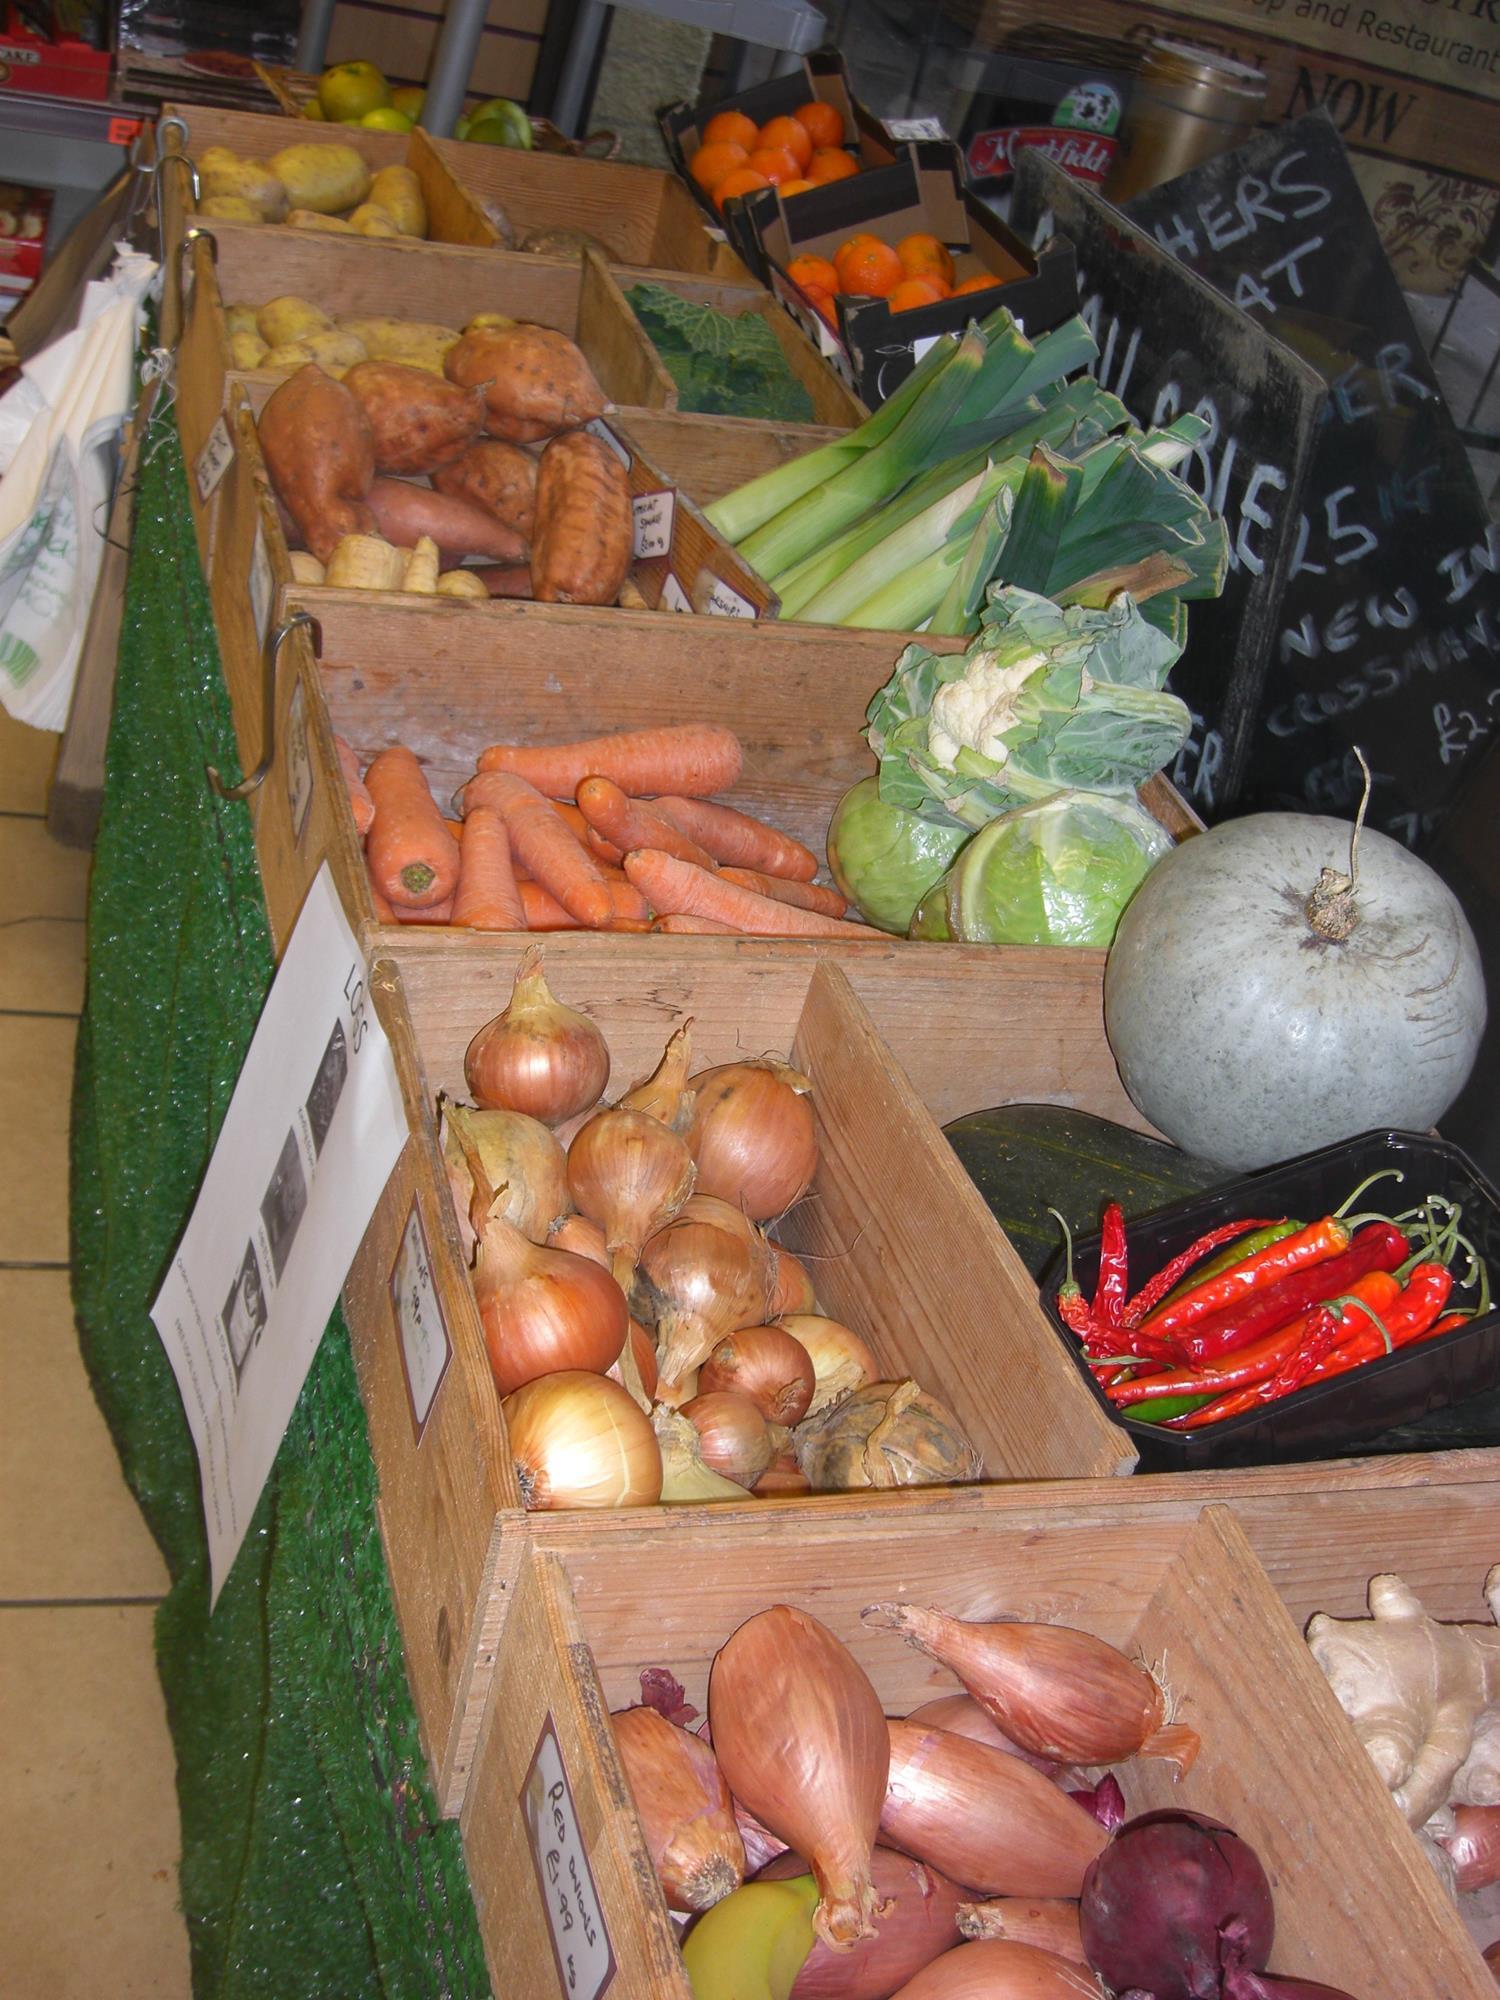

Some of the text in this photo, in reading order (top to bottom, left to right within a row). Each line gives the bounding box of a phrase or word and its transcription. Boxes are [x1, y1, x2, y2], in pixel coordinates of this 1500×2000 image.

[1294, 0, 1349, 29] and
[1355, 10, 1500, 74] Restaurant
[1281, 65, 1418, 143] NOW
[1280, 586, 1419, 665] NEW
[548, 1779, 566, 1844] RED
[545, 1848, 574, 1933] £1.99
